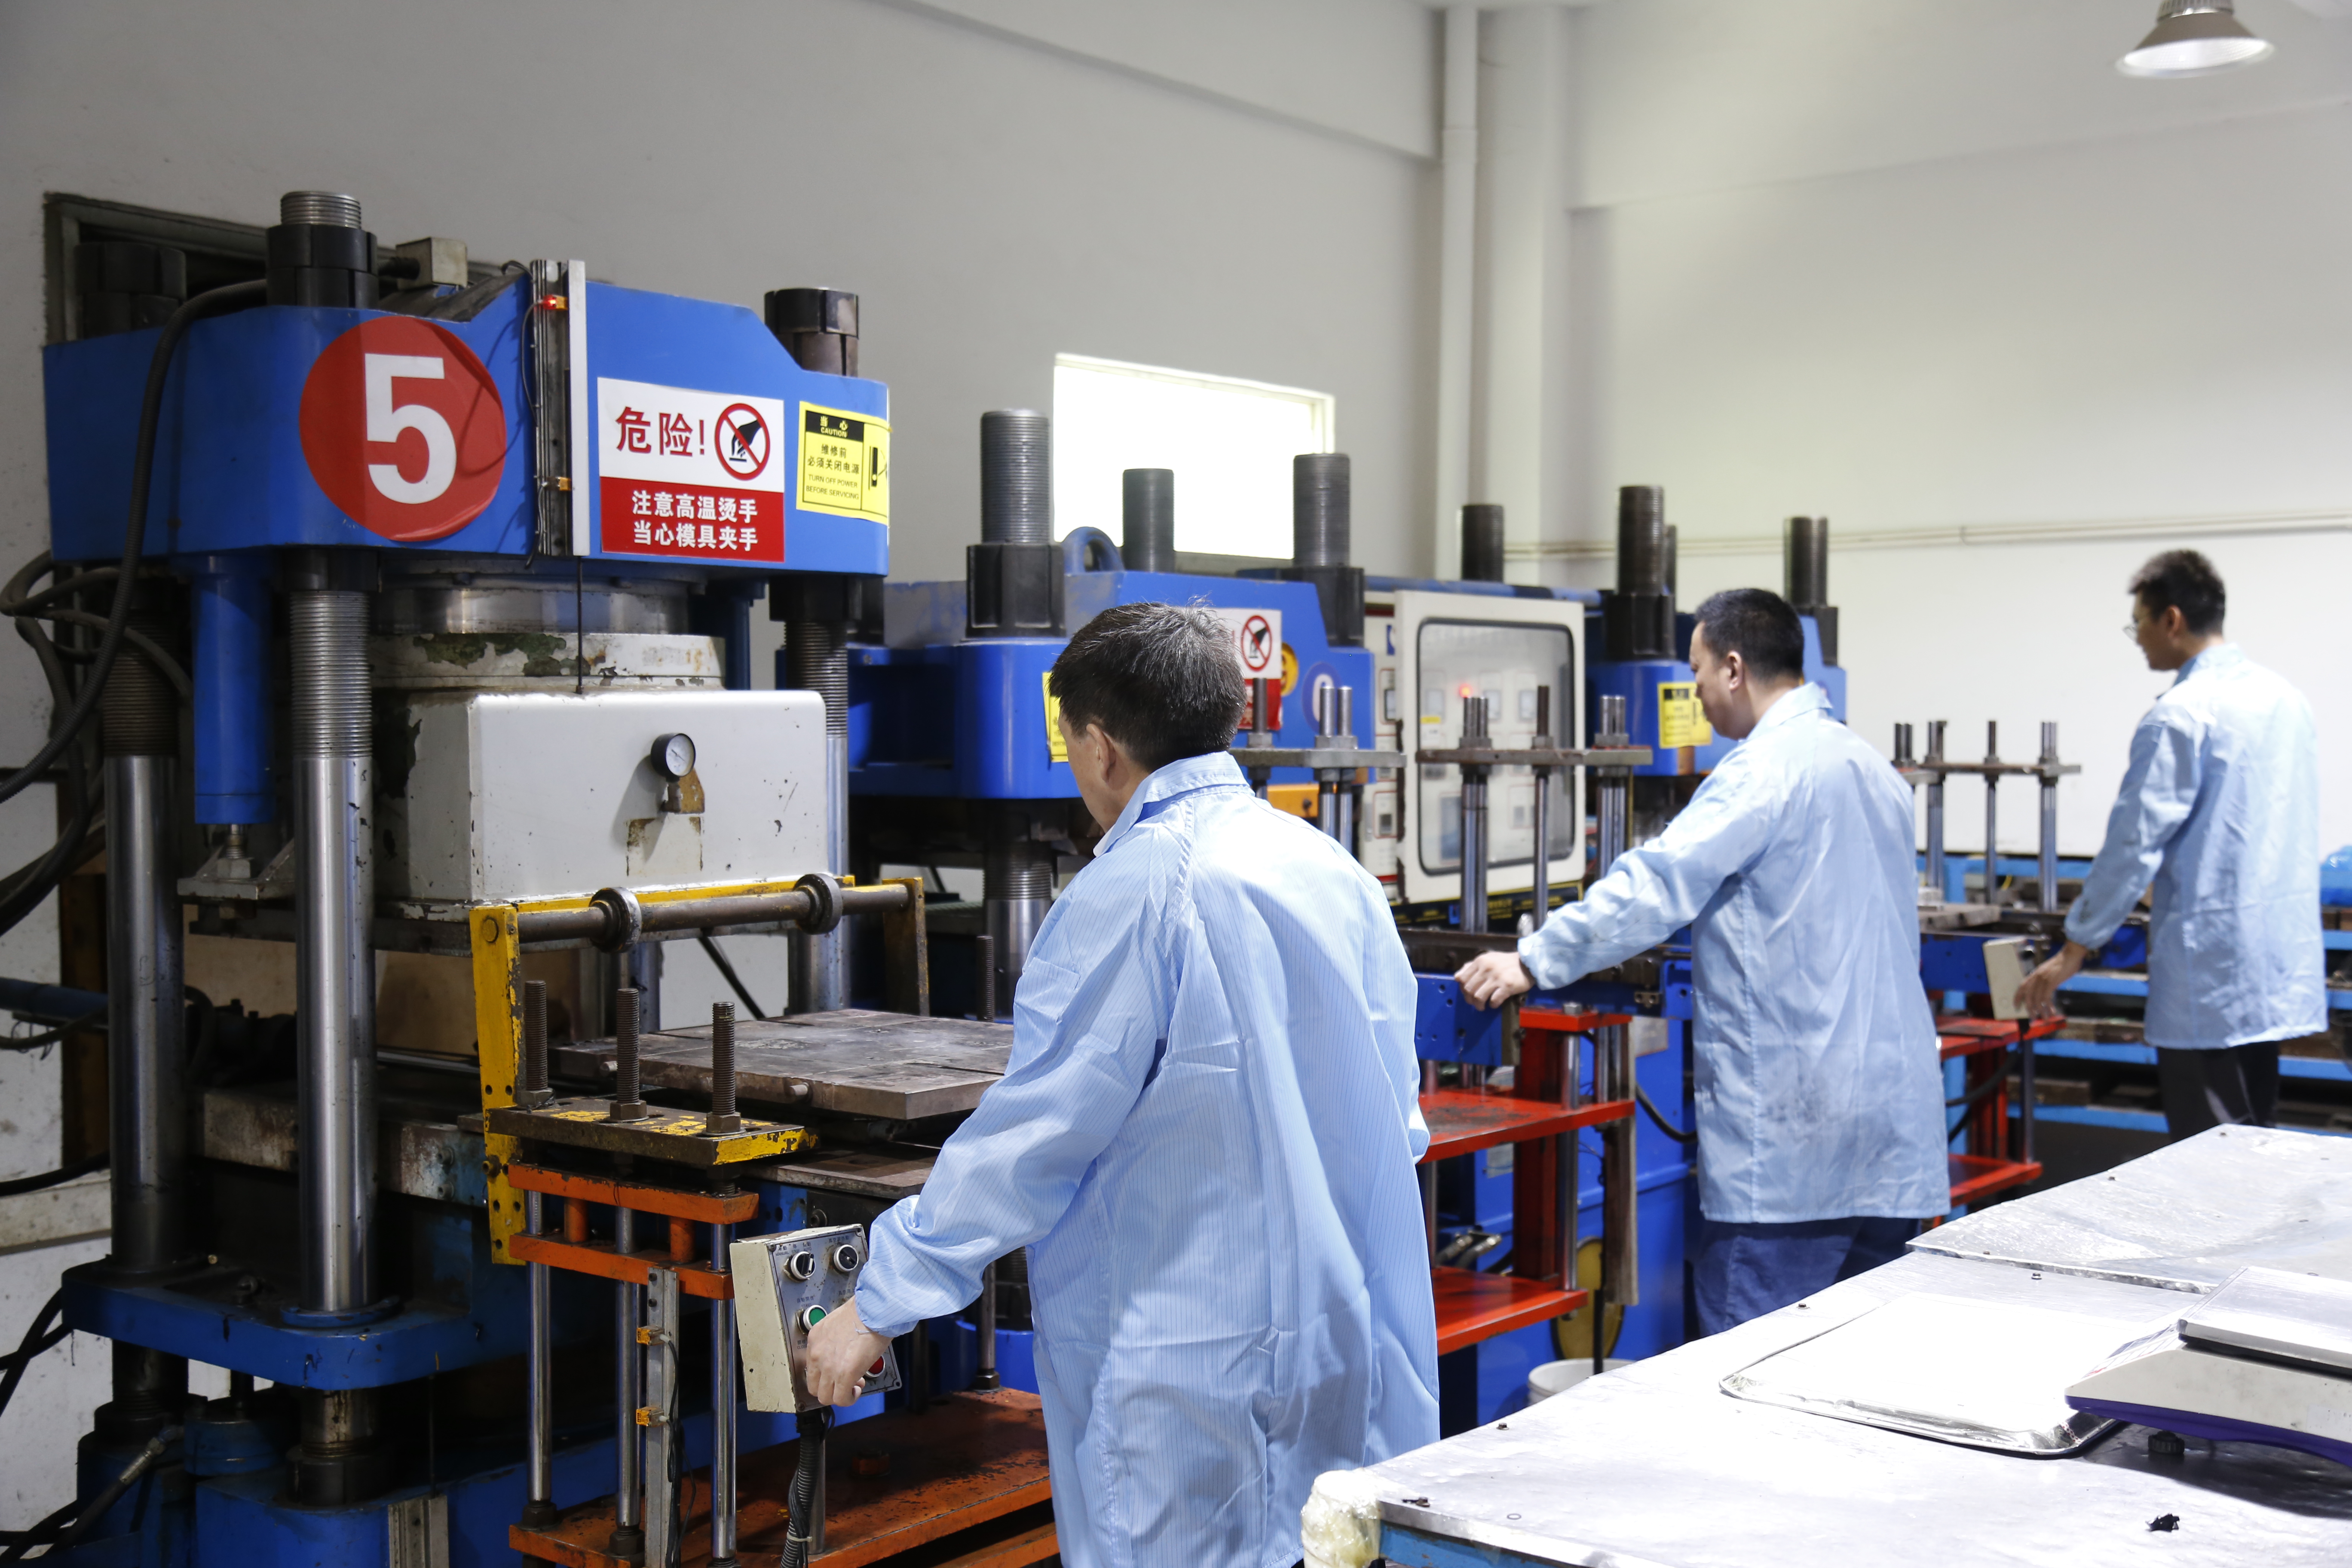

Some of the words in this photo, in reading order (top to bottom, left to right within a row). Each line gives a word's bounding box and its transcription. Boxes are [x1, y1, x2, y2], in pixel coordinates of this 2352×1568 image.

[364, 353, 457, 504] 5
[616, 407, 705, 457] 危险!
[820, 427, 848, 438] CAUTION
[821, 444, 846, 458] 维修前
[807, 456, 859, 475] 必须关闭电源
[808, 474, 824, 483] TURN
[837, 479, 858, 488] POWER
[806, 485, 827, 494] BEFORE
[829, 488, 859, 499] SERVICING
[632, 490, 758, 524] 注意高温烫手
[634, 520, 758, 551] 当心模具夹手
